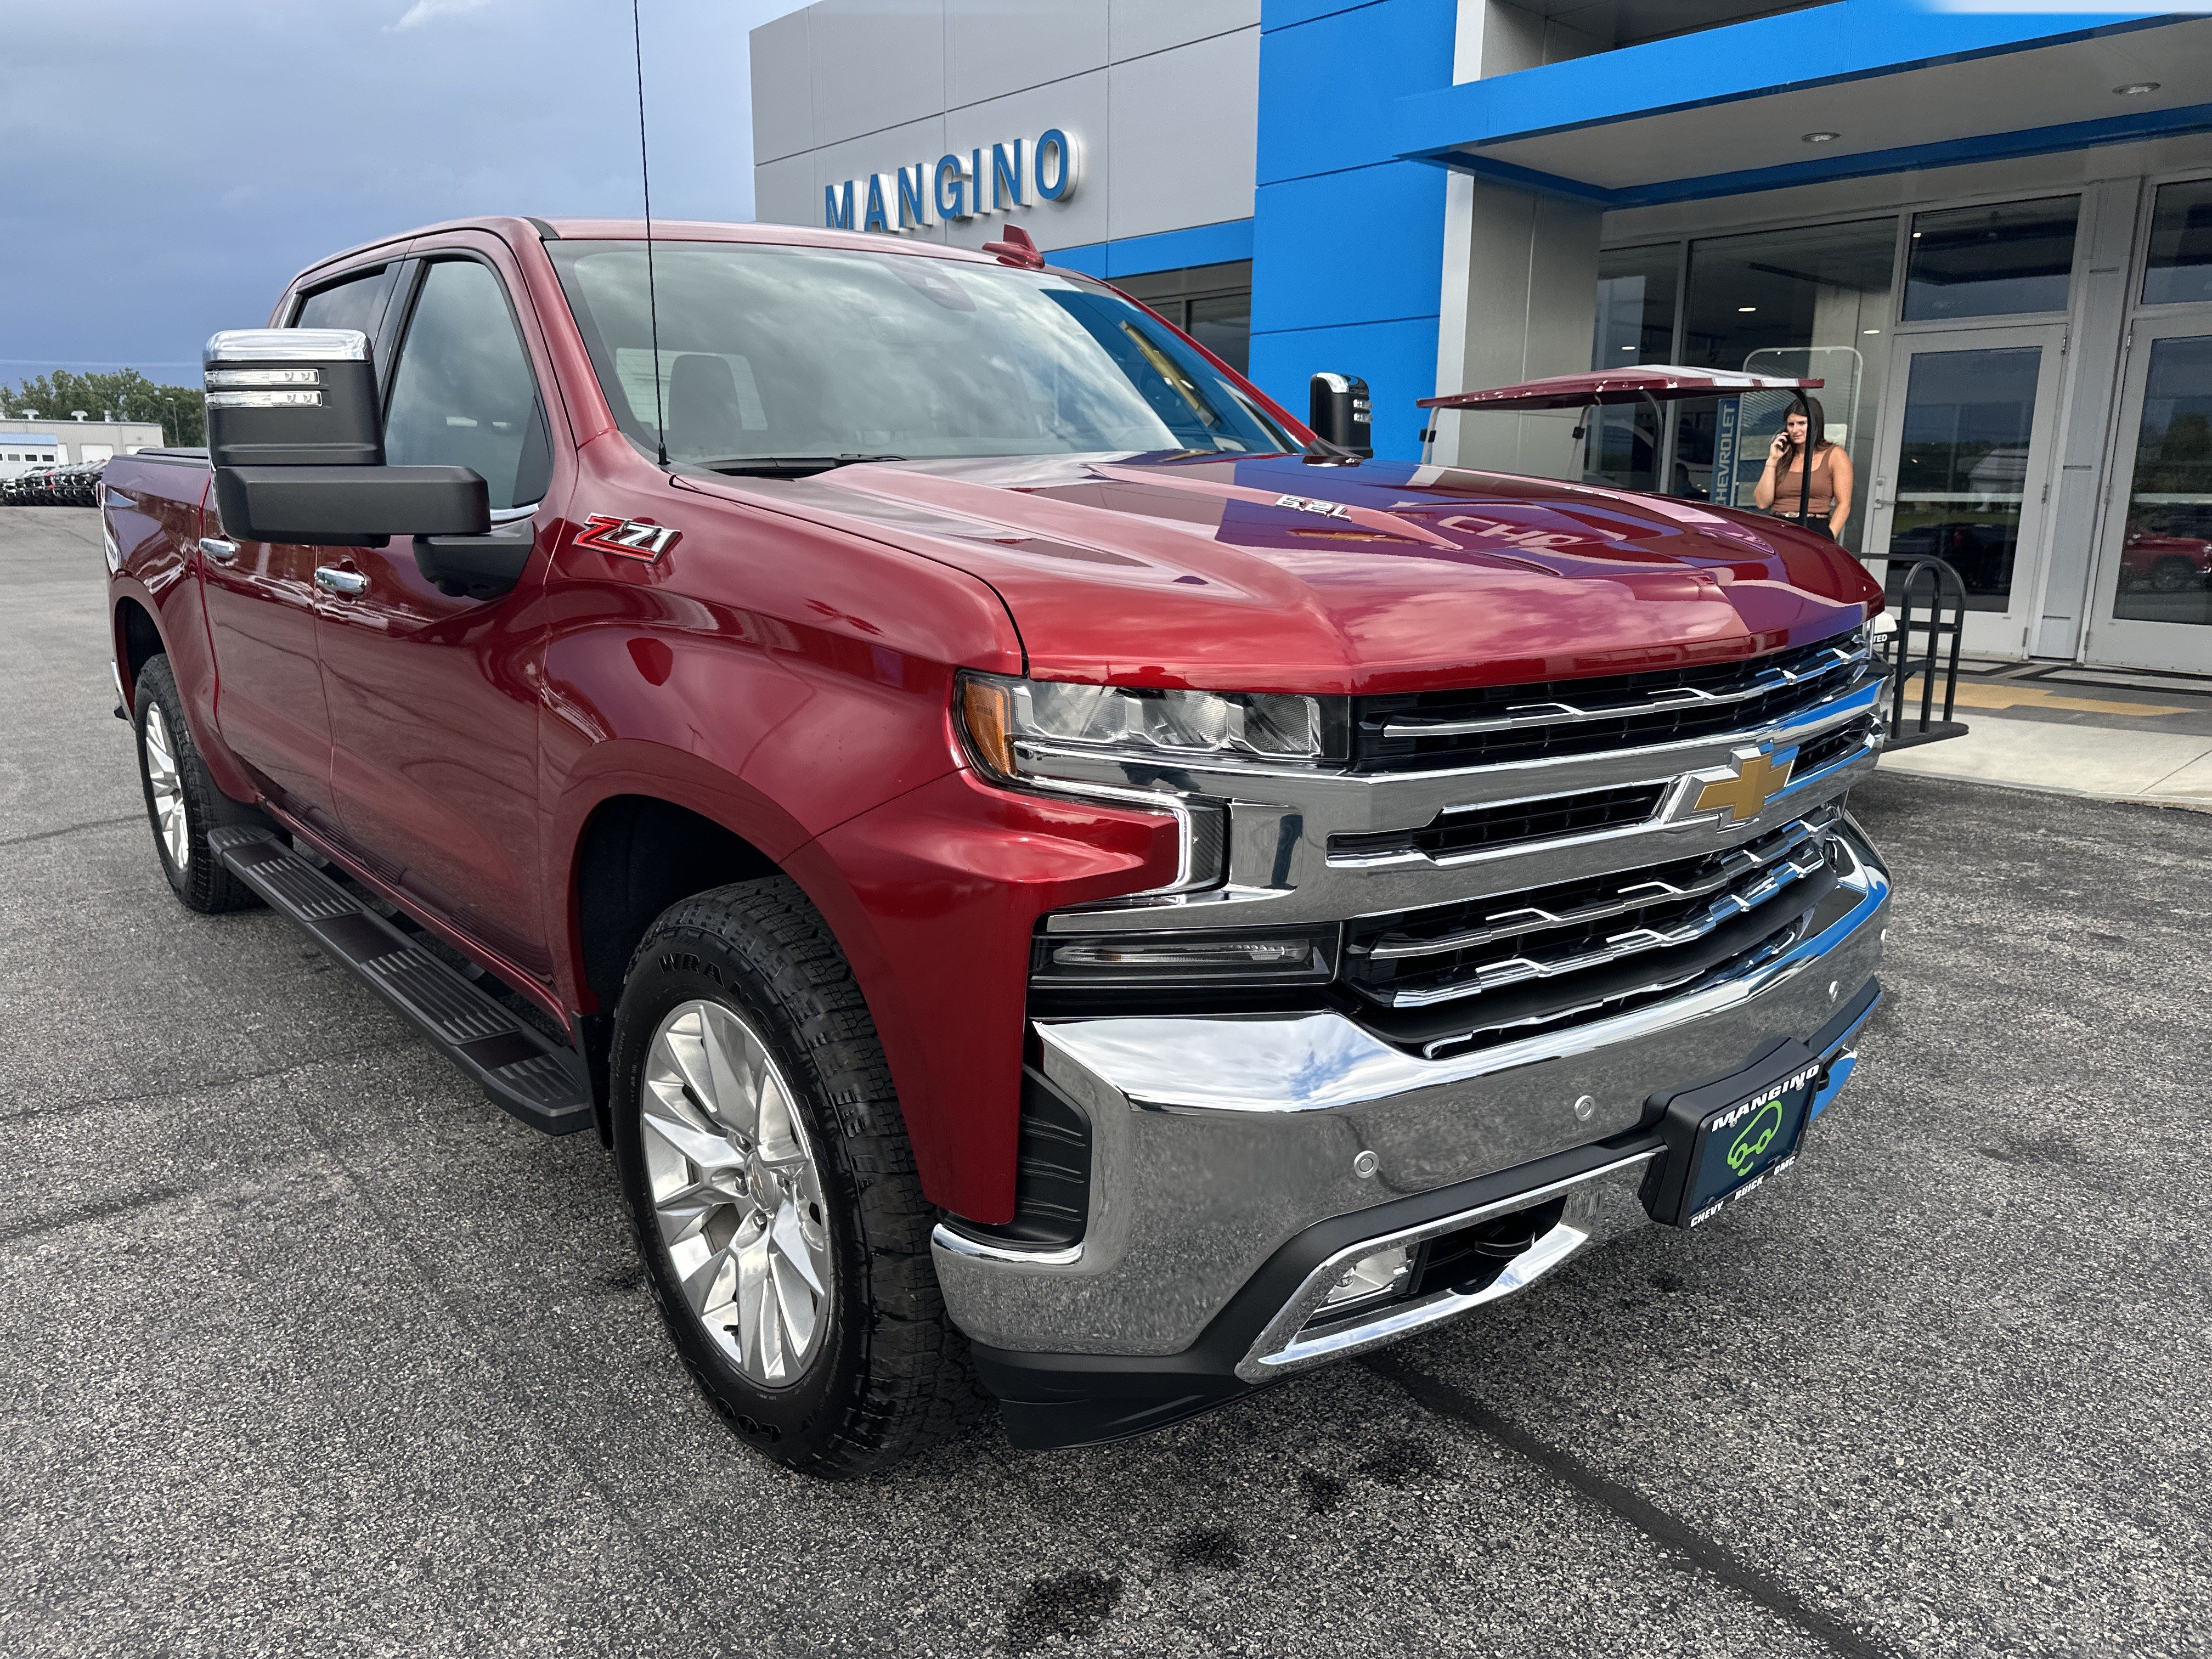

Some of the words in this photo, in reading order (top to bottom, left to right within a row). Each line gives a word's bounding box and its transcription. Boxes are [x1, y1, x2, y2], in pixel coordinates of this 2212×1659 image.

[825, 128, 1080, 232] MANGINO
[572, 512, 683, 564] Z71
[1712, 1064, 1820, 1132] MANGINO
[1690, 1200, 1724, 1227] CHEVY
[1734, 1175, 1764, 1200] BUICK
[1774, 1155, 1796, 1175] GMC
